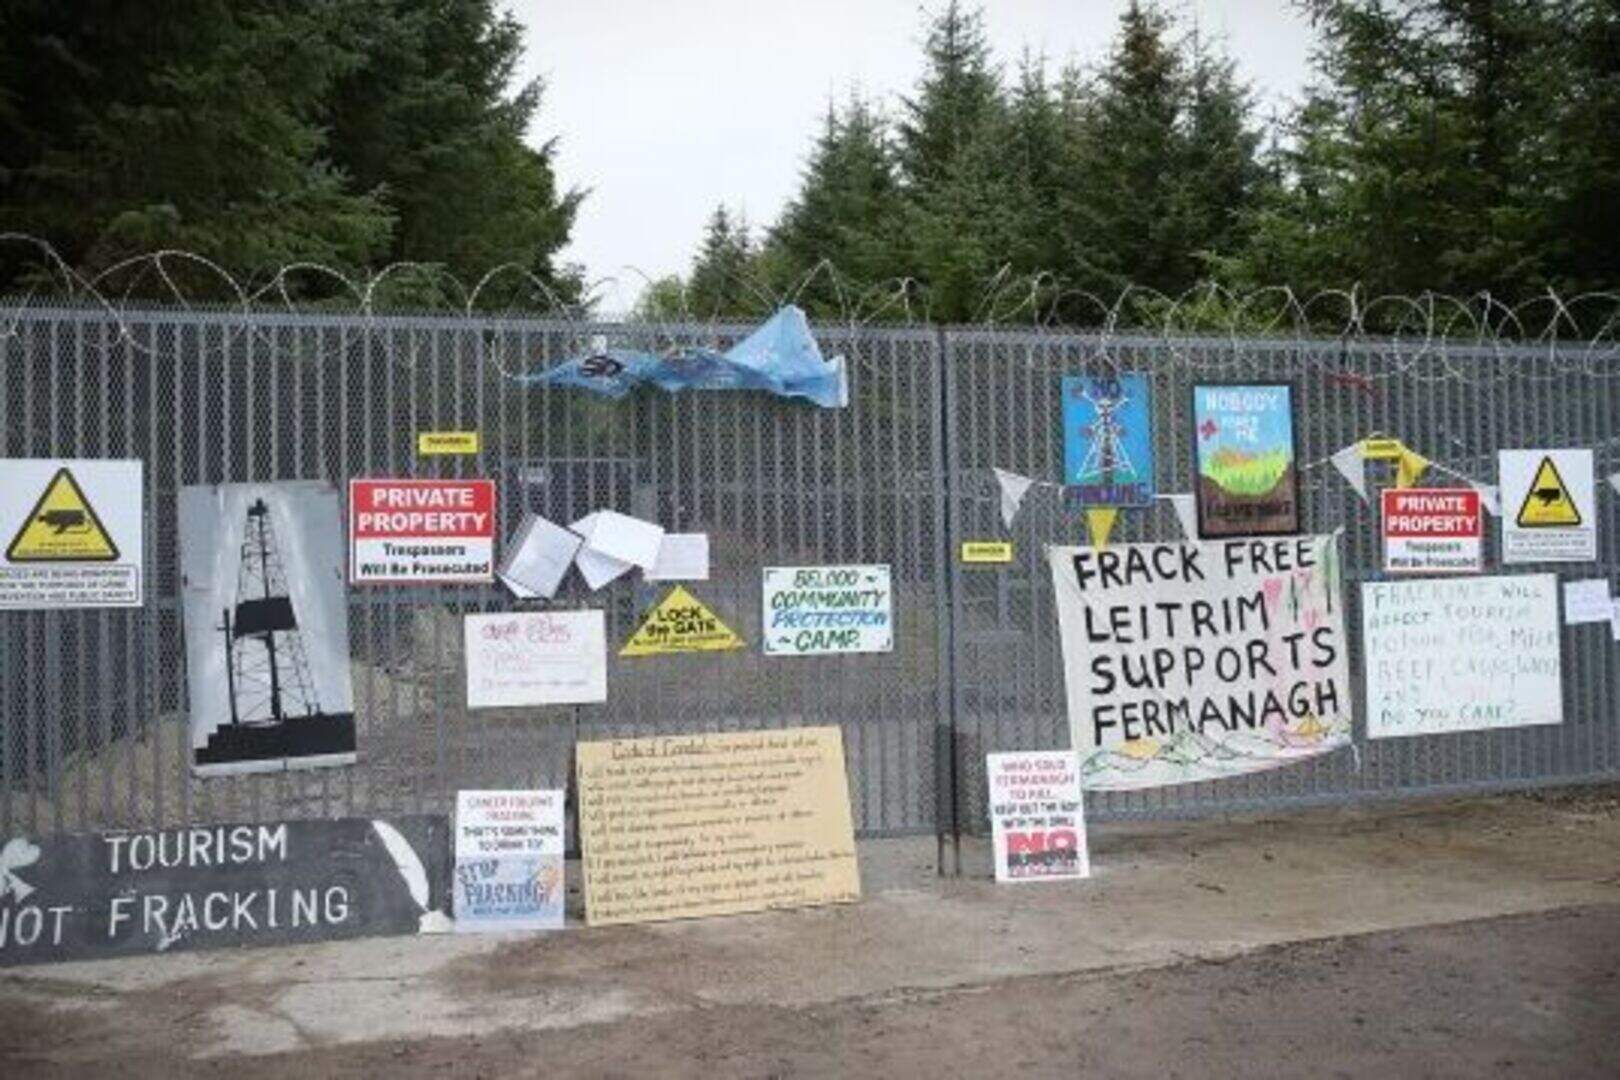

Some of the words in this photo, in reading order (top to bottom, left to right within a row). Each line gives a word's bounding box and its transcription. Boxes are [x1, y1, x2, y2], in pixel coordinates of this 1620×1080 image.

[372, 487, 475, 508] PRIVATE
[1396, 495, 1467, 512] PRIVATE
[358, 511, 488, 532] PROPERTY
[1388, 514, 1477, 532] PROPERTY
[1073, 546, 1205, 590] FRACK
[1224, 537, 1318, 579] FREE
[771, 590, 887, 611] COMMUNITY
[656, 607, 702, 622] LOCK
[1085, 591, 1269, 643] LEITRIM
[674, 620, 716, 635] GATE
[1091, 627, 1336, 695] SUPPORTS
[1092, 678, 1338, 746] FERMANAGH
[105, 824, 288, 873] TOURISM
[1007, 831, 1080, 854] NO
[107, 886, 349, 938] FRACKING
